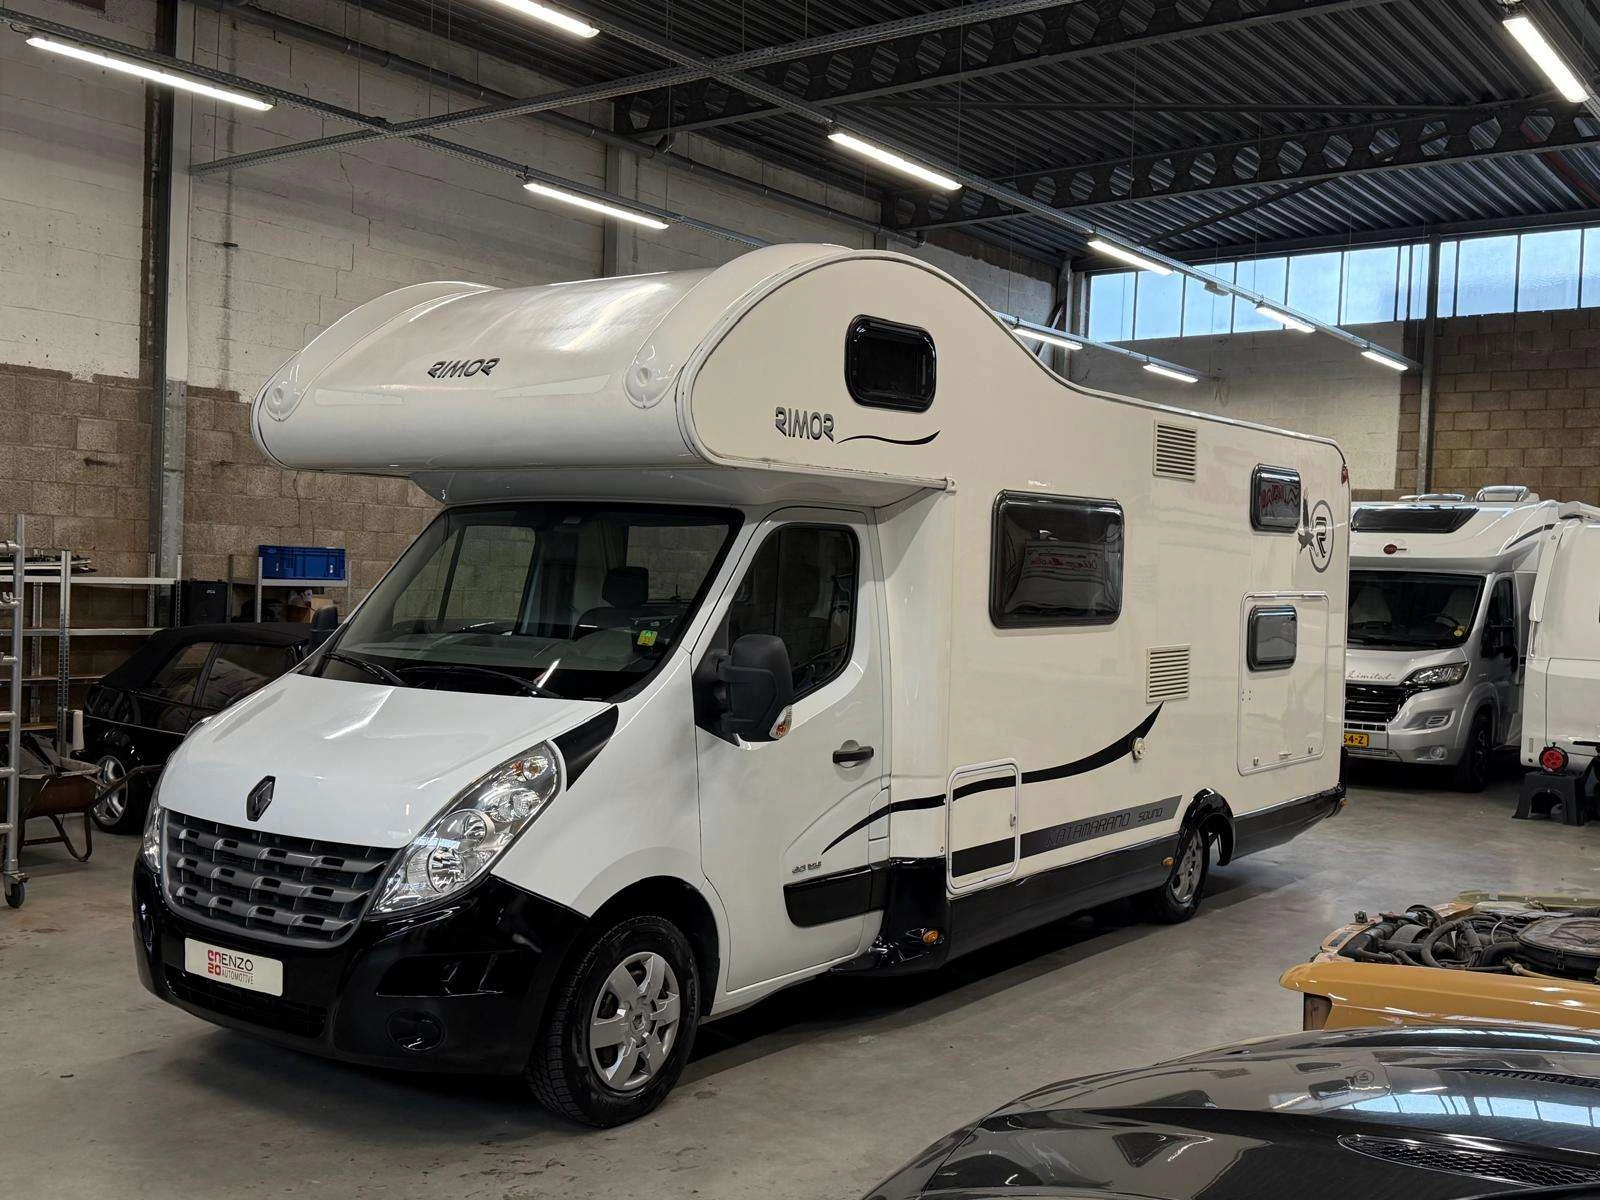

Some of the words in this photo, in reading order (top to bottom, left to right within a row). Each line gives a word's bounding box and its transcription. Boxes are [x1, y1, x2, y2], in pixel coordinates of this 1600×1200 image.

[427, 357, 501, 379] RIMOR
[775, 406, 835, 442] RIMOR
[221, 953, 254, 972] ENZO
[221, 968, 254, 985] AUTOMOTIVE
